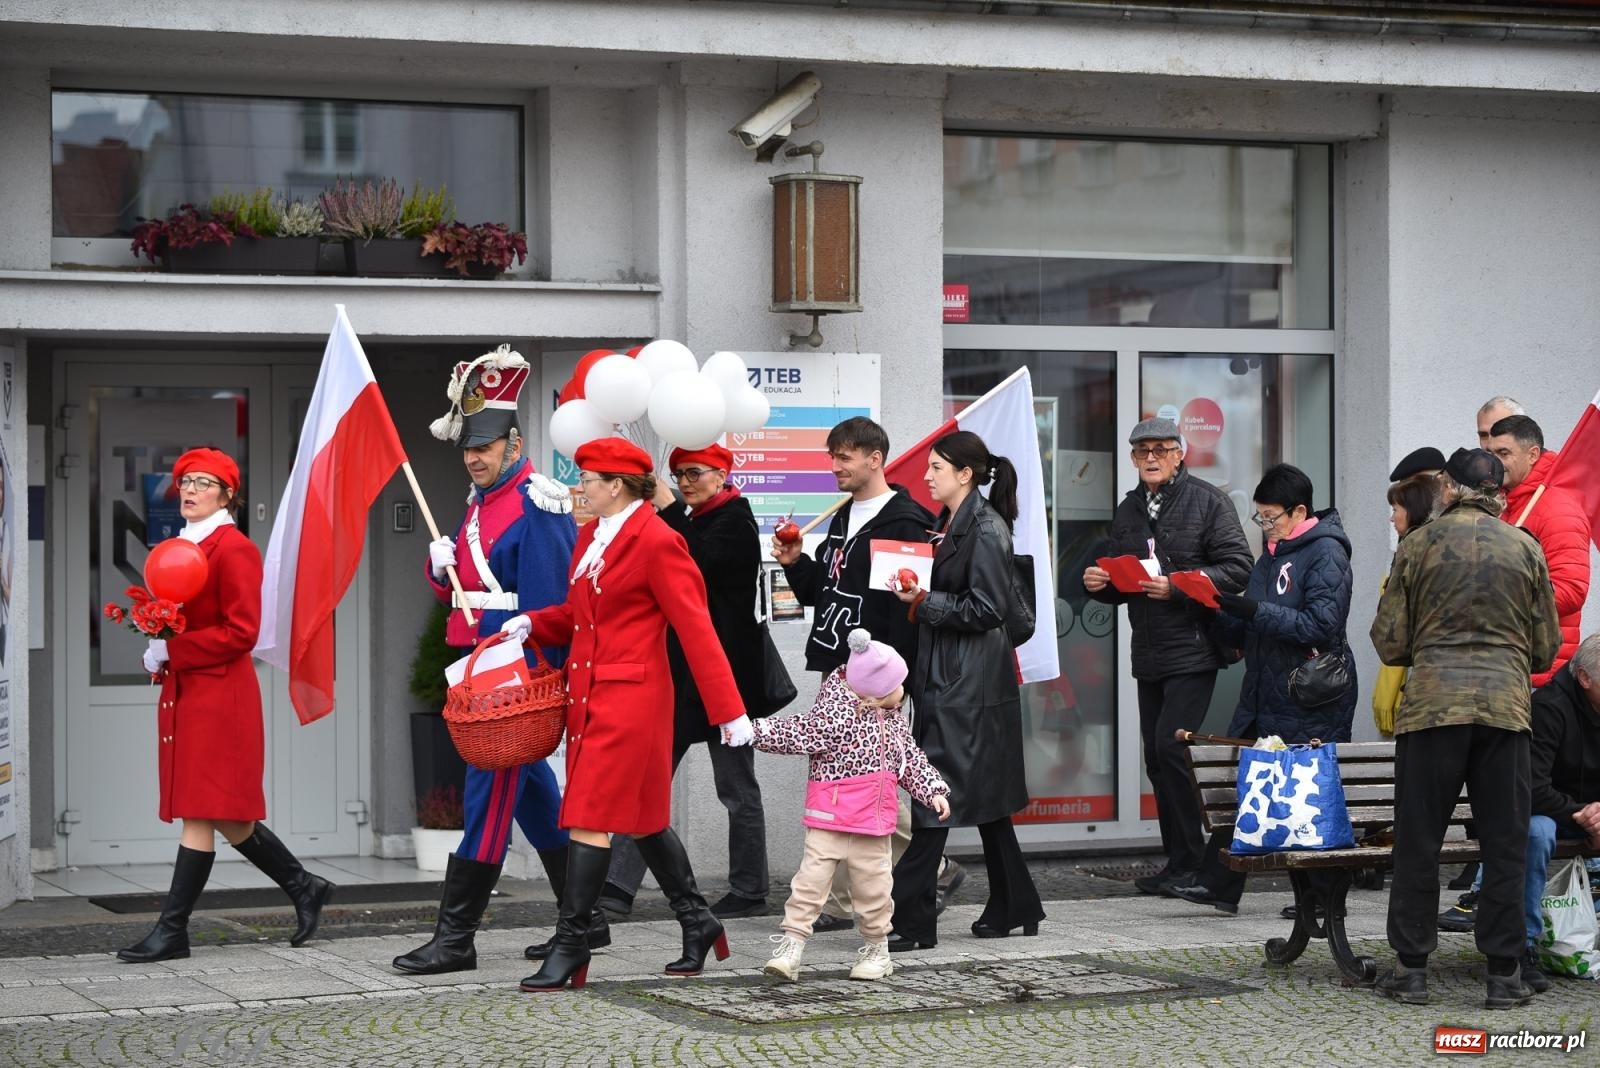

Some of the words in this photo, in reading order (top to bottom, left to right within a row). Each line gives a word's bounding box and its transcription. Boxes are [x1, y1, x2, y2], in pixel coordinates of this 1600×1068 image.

[764, 368, 801, 384] TEB
[747, 431, 765, 440] TEB
[747, 453, 765, 462] TEB
[747, 475, 766, 484] TEB
[748, 496, 765, 505] TEB
